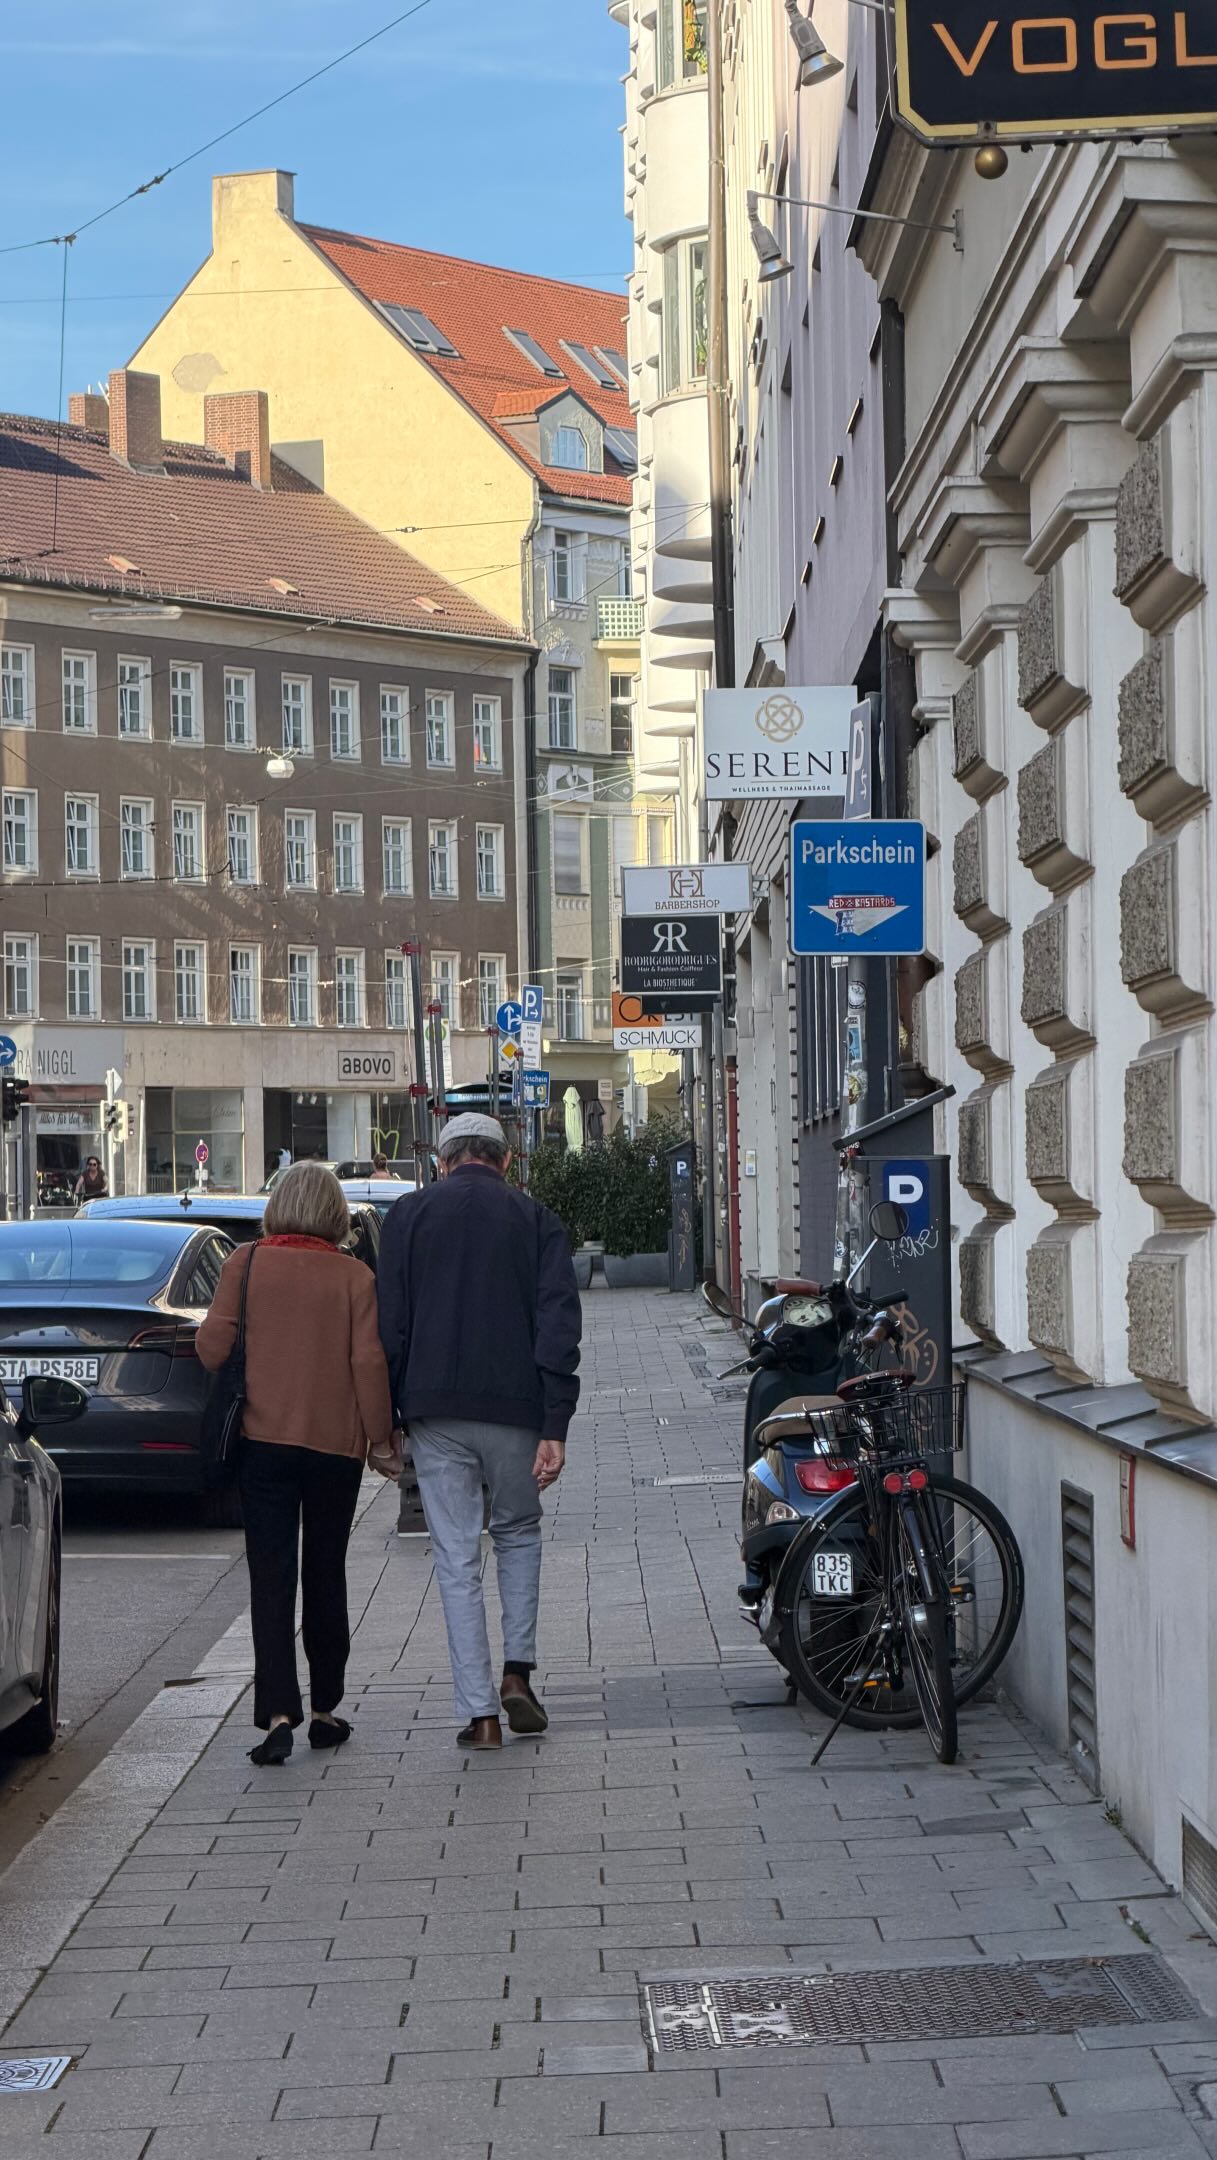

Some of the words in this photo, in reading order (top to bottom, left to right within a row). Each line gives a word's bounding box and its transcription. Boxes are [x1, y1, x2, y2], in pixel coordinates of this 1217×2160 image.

[932, 12, 1217, 77] VOGL
[802, 839, 915, 864] Parkschein
[655, 899, 720, 910] BARBERSHOP
[828, 898, 845, 908] RED
[854, 897, 896, 908] BASTARDS
[643, 978, 651, 988] LA
[525, 990, 537, 1018] P
[620, 1030, 696, 1046] SCHMUCK
[38, 1050, 76, 1075] NIGGL
[677, 1161, 687, 1175] P
[0, 1360, 28, 1378] STA
[816, 1555, 849, 1572] 835
[817, 1575, 849, 1592] TKC
